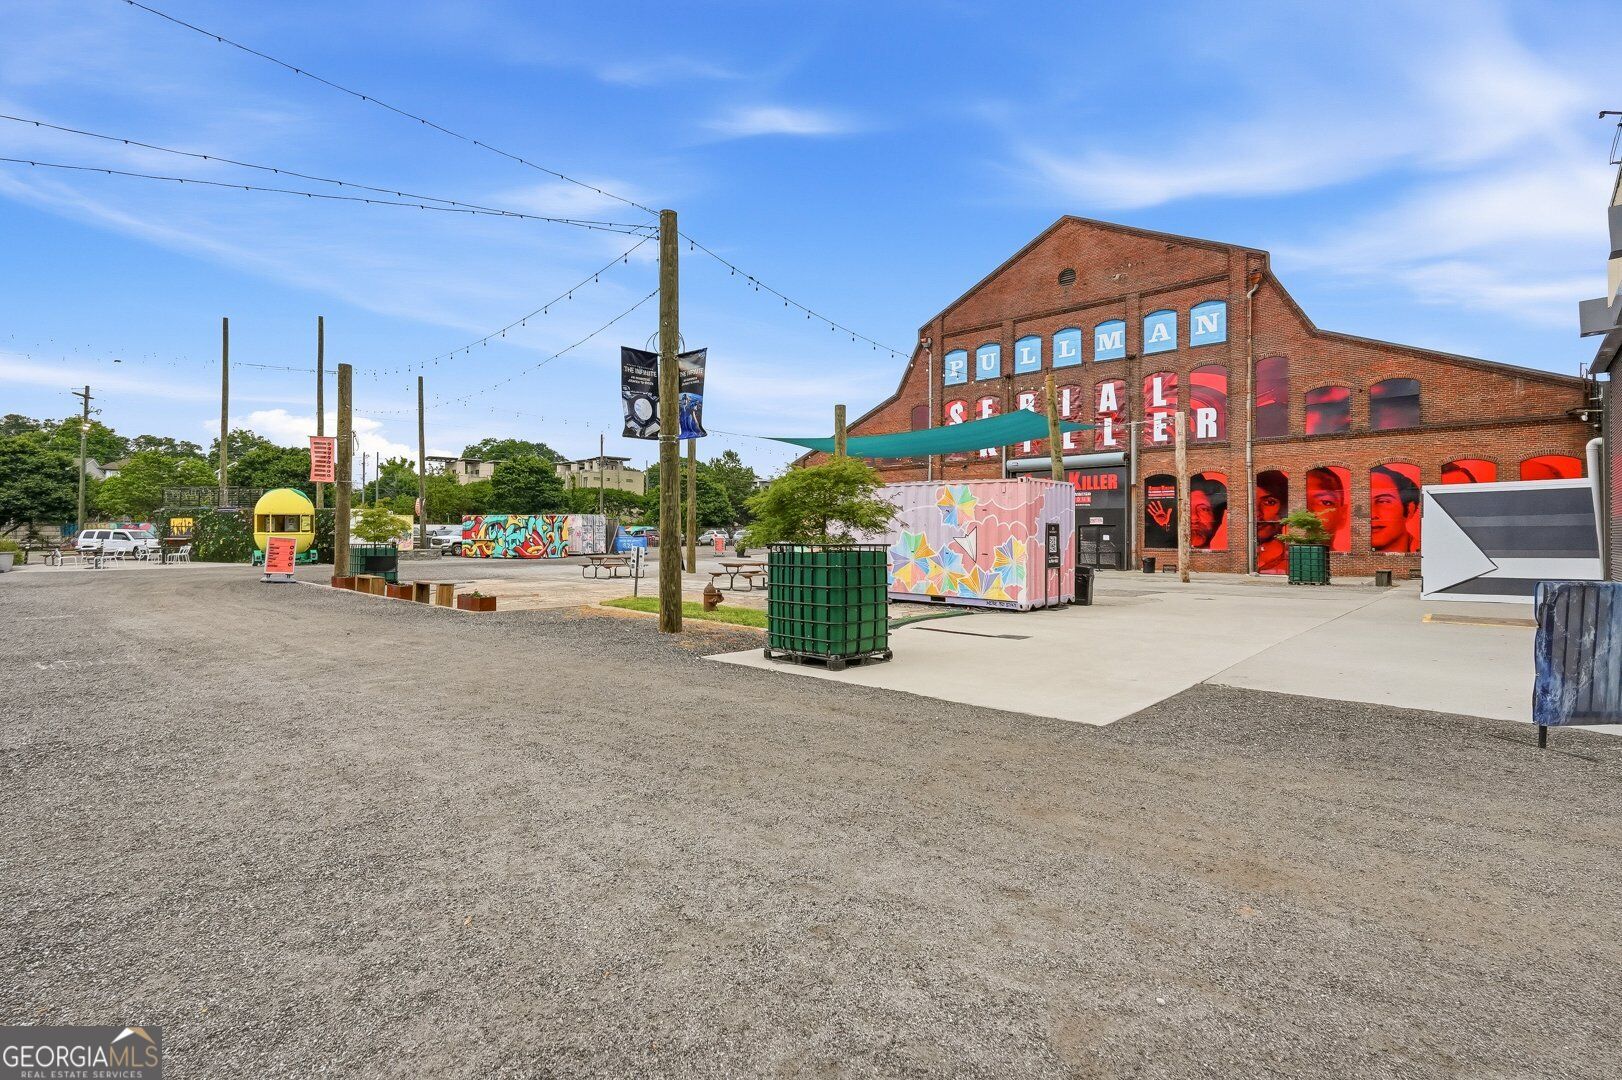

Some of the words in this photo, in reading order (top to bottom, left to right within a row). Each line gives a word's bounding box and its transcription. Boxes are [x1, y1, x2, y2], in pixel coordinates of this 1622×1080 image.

[949, 312, 1219, 377] PULLMAN
[949, 376, 1167, 426] SERIAL
[1068, 471, 1118, 491] KILLER
